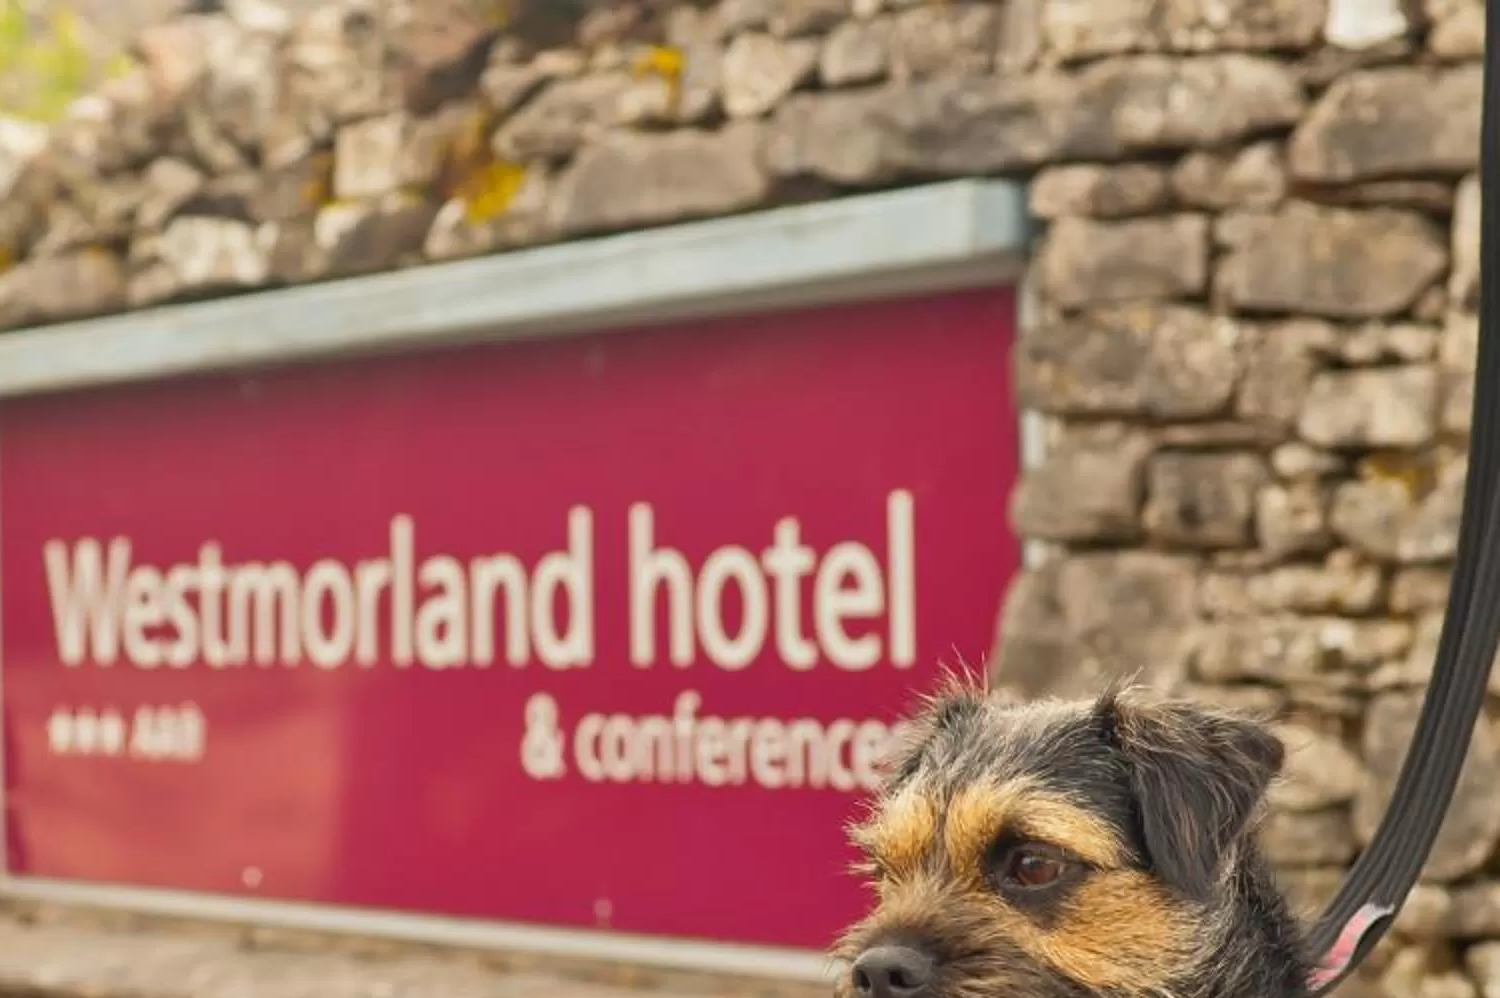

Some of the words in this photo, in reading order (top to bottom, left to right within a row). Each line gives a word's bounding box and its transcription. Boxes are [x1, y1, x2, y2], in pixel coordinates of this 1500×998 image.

[45, 504, 595, 669] Westmorland
[628, 489, 917, 670] hotel
[520, 693, 565, 780] &
